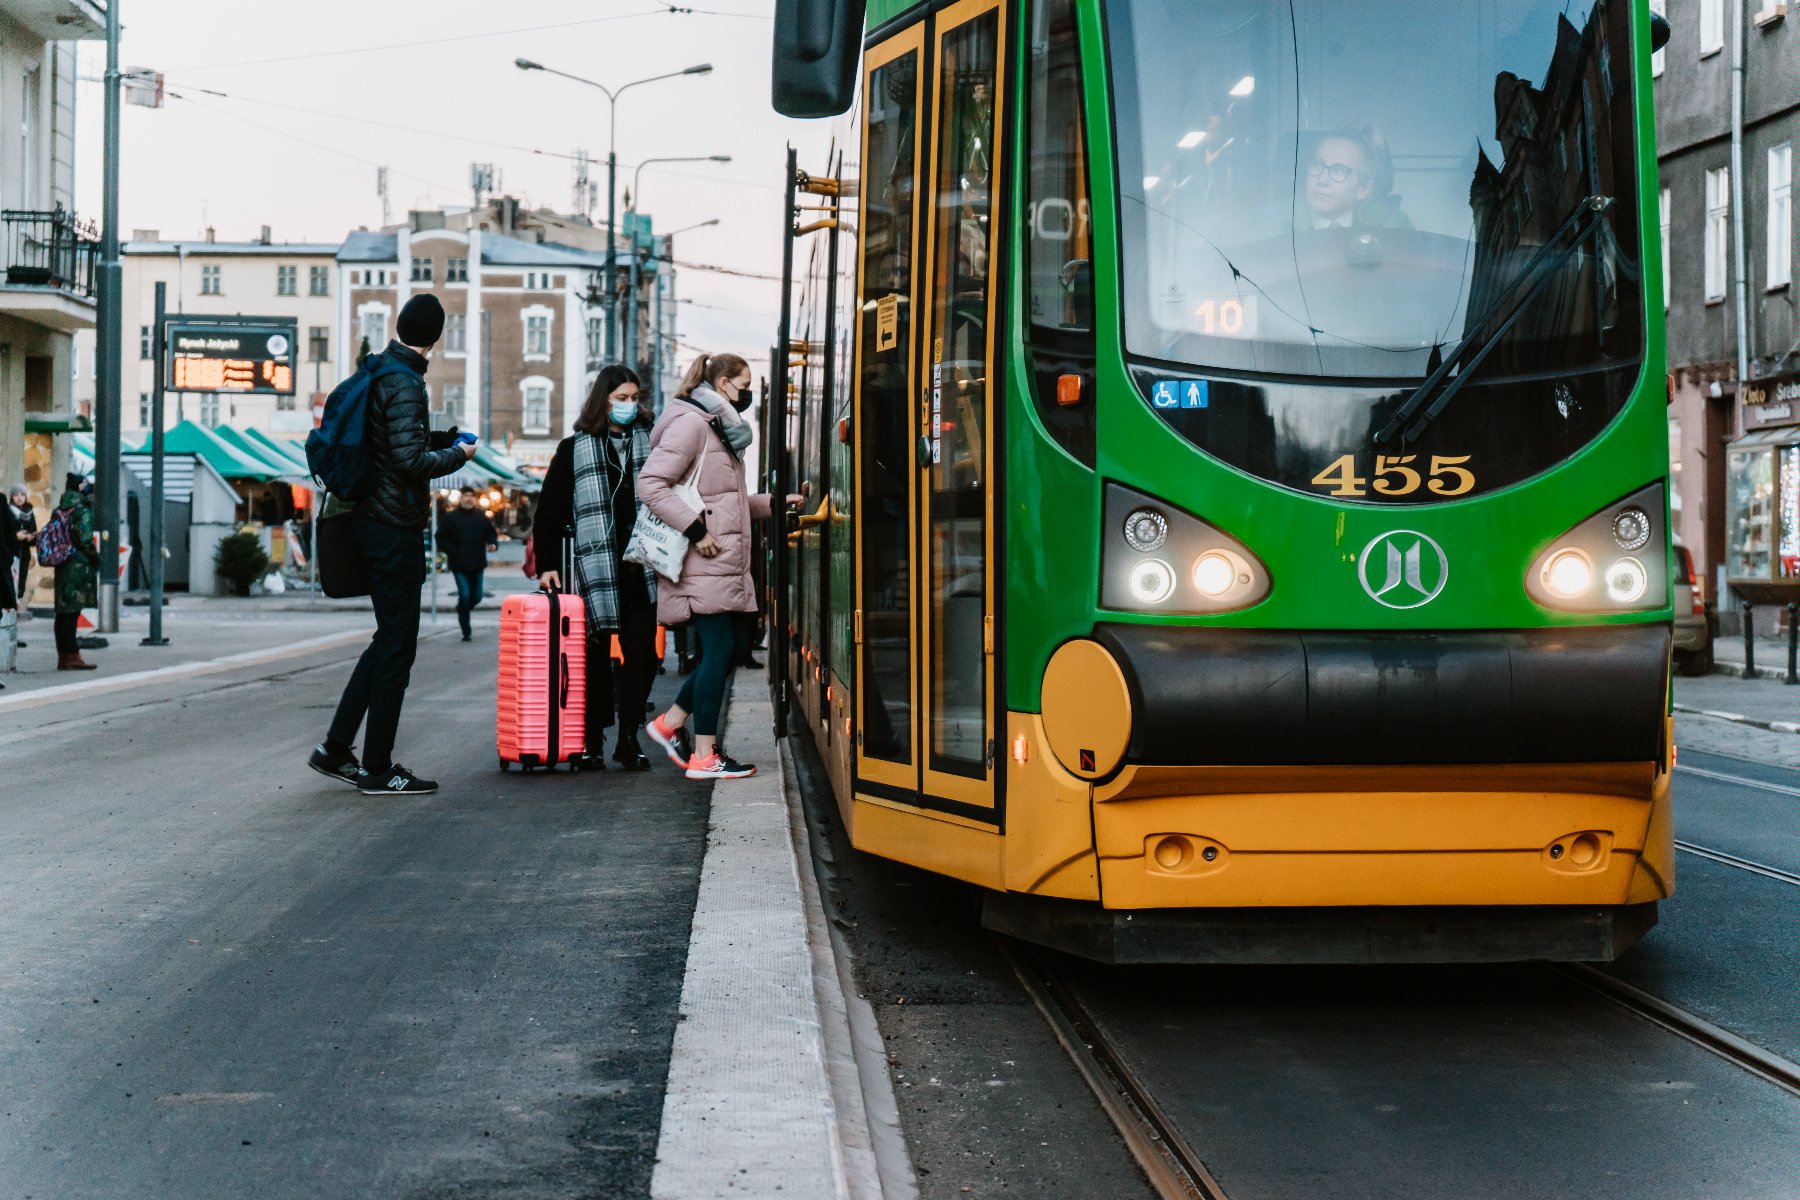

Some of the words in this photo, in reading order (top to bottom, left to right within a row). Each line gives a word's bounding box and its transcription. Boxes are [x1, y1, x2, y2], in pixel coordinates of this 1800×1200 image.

[1193, 298, 1243, 333] 10
[1311, 454, 1476, 496] 455
[387, 775, 410, 791] N
